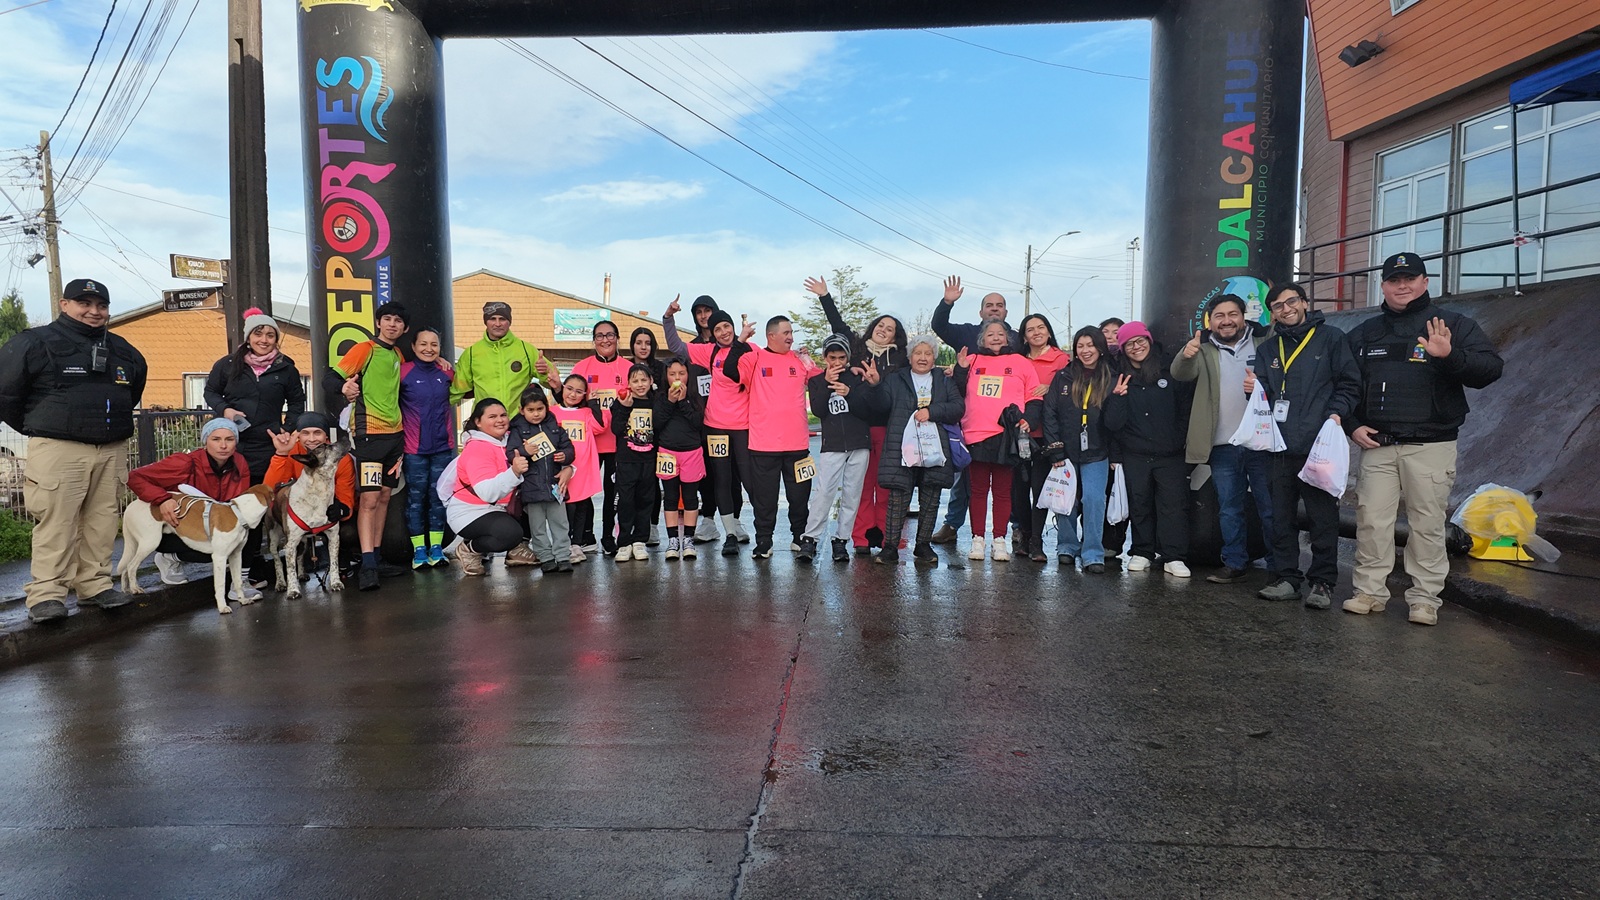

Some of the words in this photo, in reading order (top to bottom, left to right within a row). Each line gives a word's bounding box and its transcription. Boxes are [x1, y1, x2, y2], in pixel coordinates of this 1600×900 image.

[1260, 57, 1274, 159] COMUNITARIO
[1216, 28, 1260, 268] DALCAHUE
[1256, 164, 1269, 241] MUNICIPIO
[315, 55, 397, 368] DEPORTES
[379, 264, 389, 306] CAHUE
[179, 291, 208, 300] MONSEÑOR
[1198, 287, 1221, 309] DALCAS
[700, 382, 711, 395] 13
[980, 383, 1000, 397] 157
[828, 399, 847, 413] 138
[633, 416, 651, 429] 154
[710, 443, 727, 456] 148
[658, 460, 674, 474] 149
[796, 465, 815, 480] 150
[364, 471, 382, 485] 146
